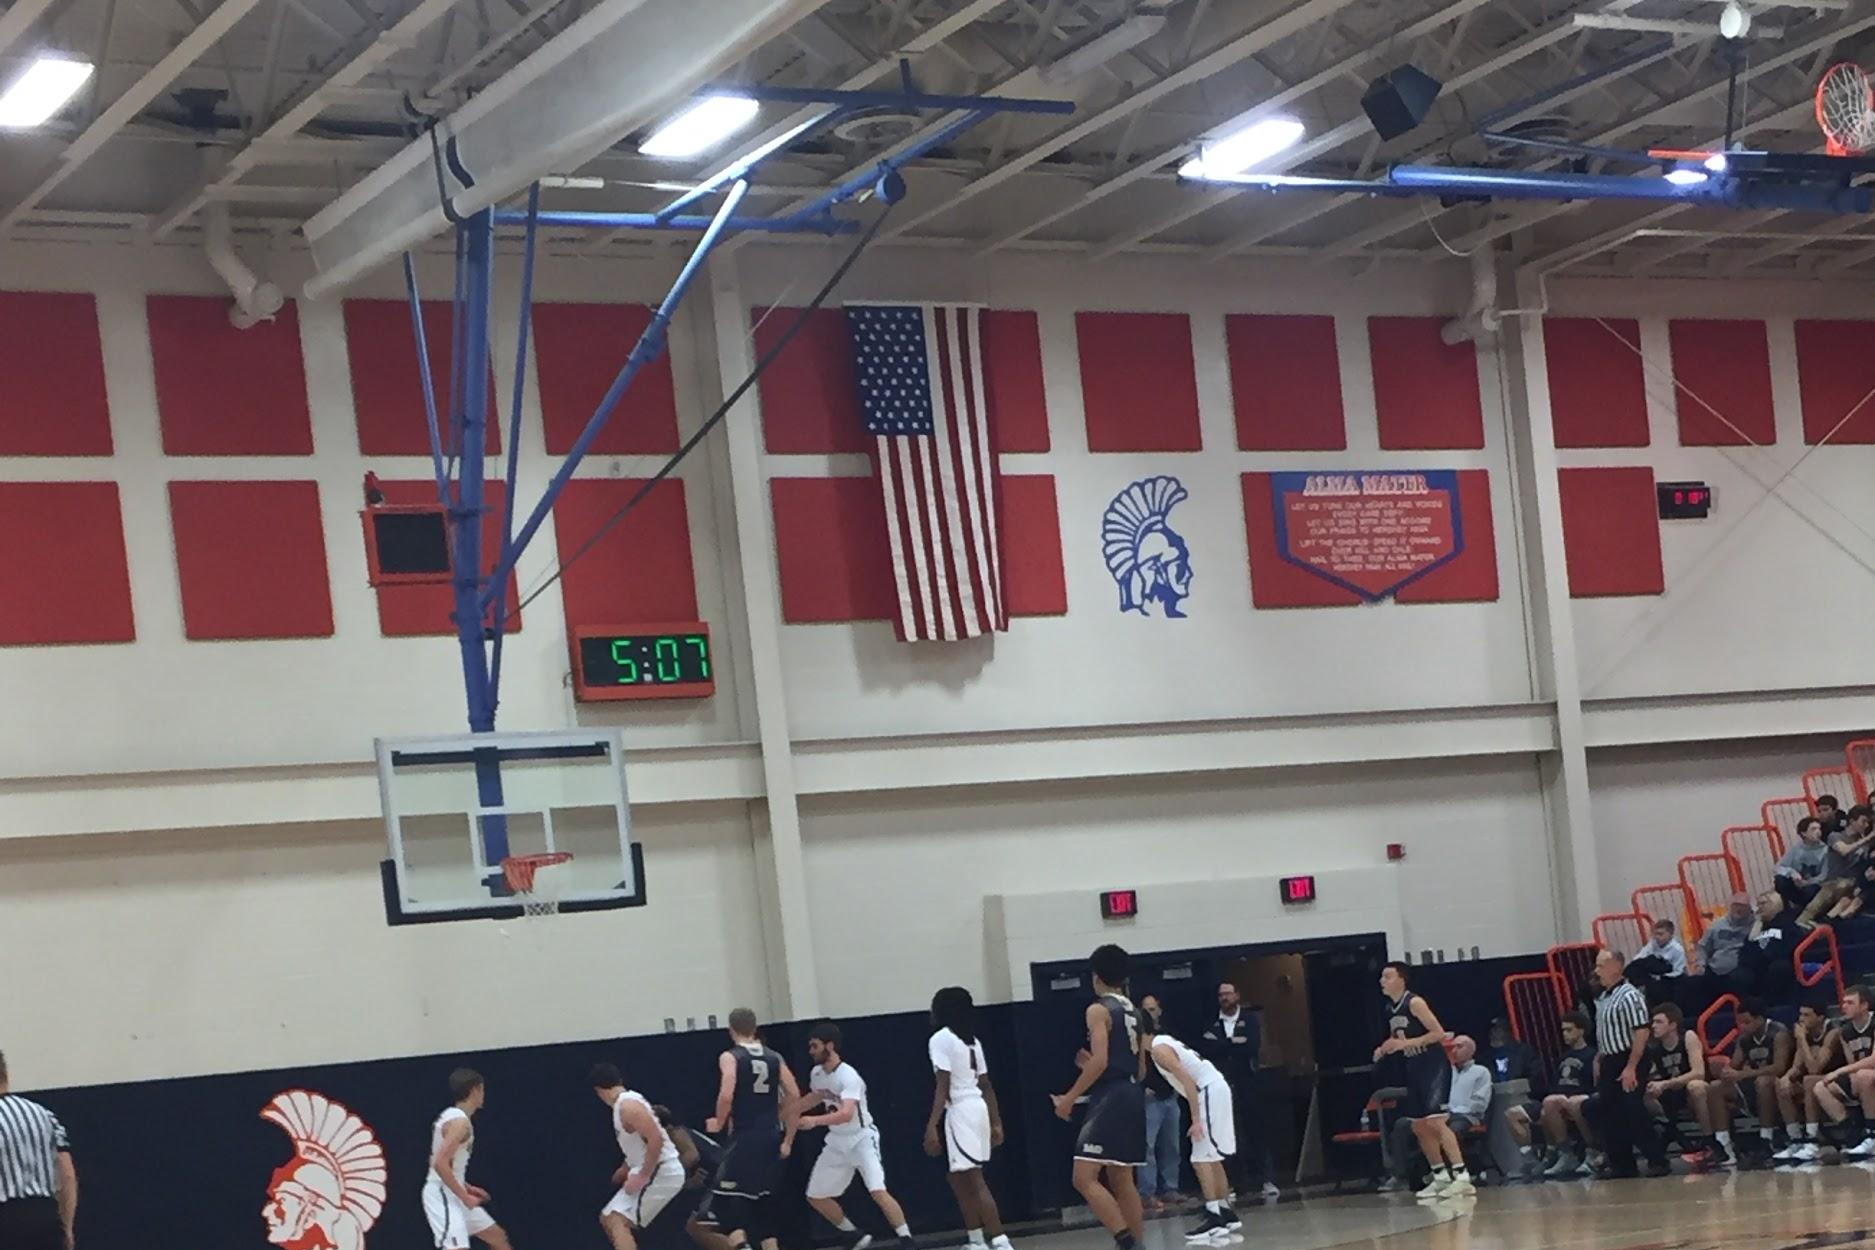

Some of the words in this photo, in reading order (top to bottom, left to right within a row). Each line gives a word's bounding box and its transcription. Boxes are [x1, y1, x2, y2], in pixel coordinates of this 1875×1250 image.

[1302, 475, 1360, 496] ALMA
[1361, 474, 1429, 495] MATER
[610, 637, 708, 684] 5:07
[751, 1059, 770, 1093] 2
